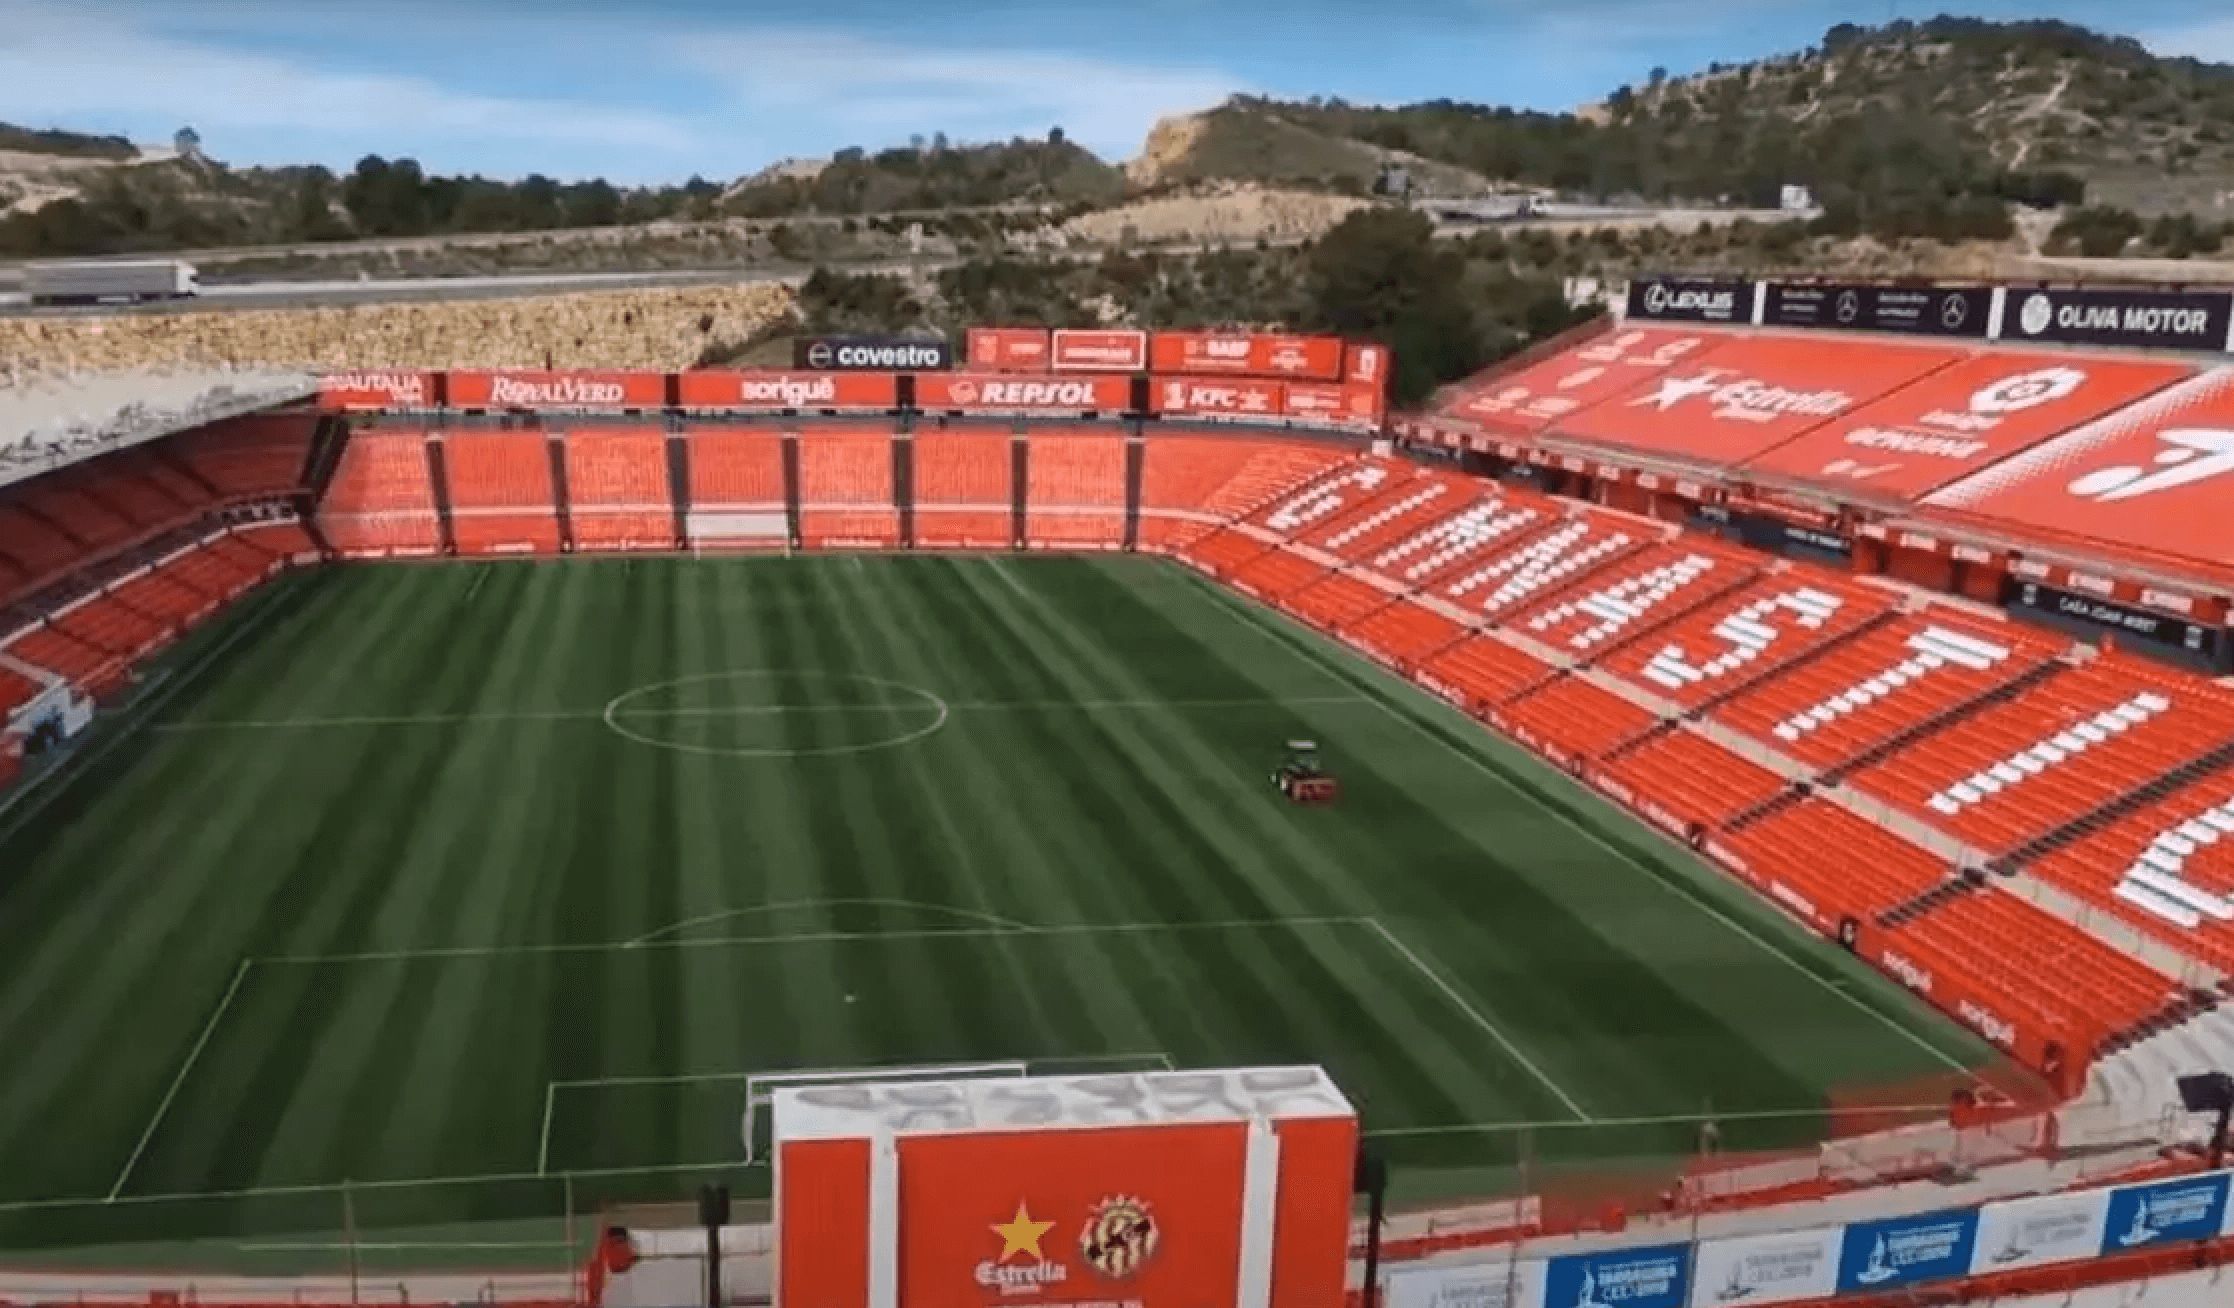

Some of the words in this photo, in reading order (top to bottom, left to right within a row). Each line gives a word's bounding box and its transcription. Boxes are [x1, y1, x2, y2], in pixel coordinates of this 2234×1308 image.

[2057, 304, 2119, 329] OLIVA
[2123, 306, 2208, 334] MOTOR
[837, 345, 941, 367] covestro
[981, 382, 1097, 404] REPSOL
[1189, 386, 1238, 407] KFC
[974, 1259, 1067, 1286] Estrella
